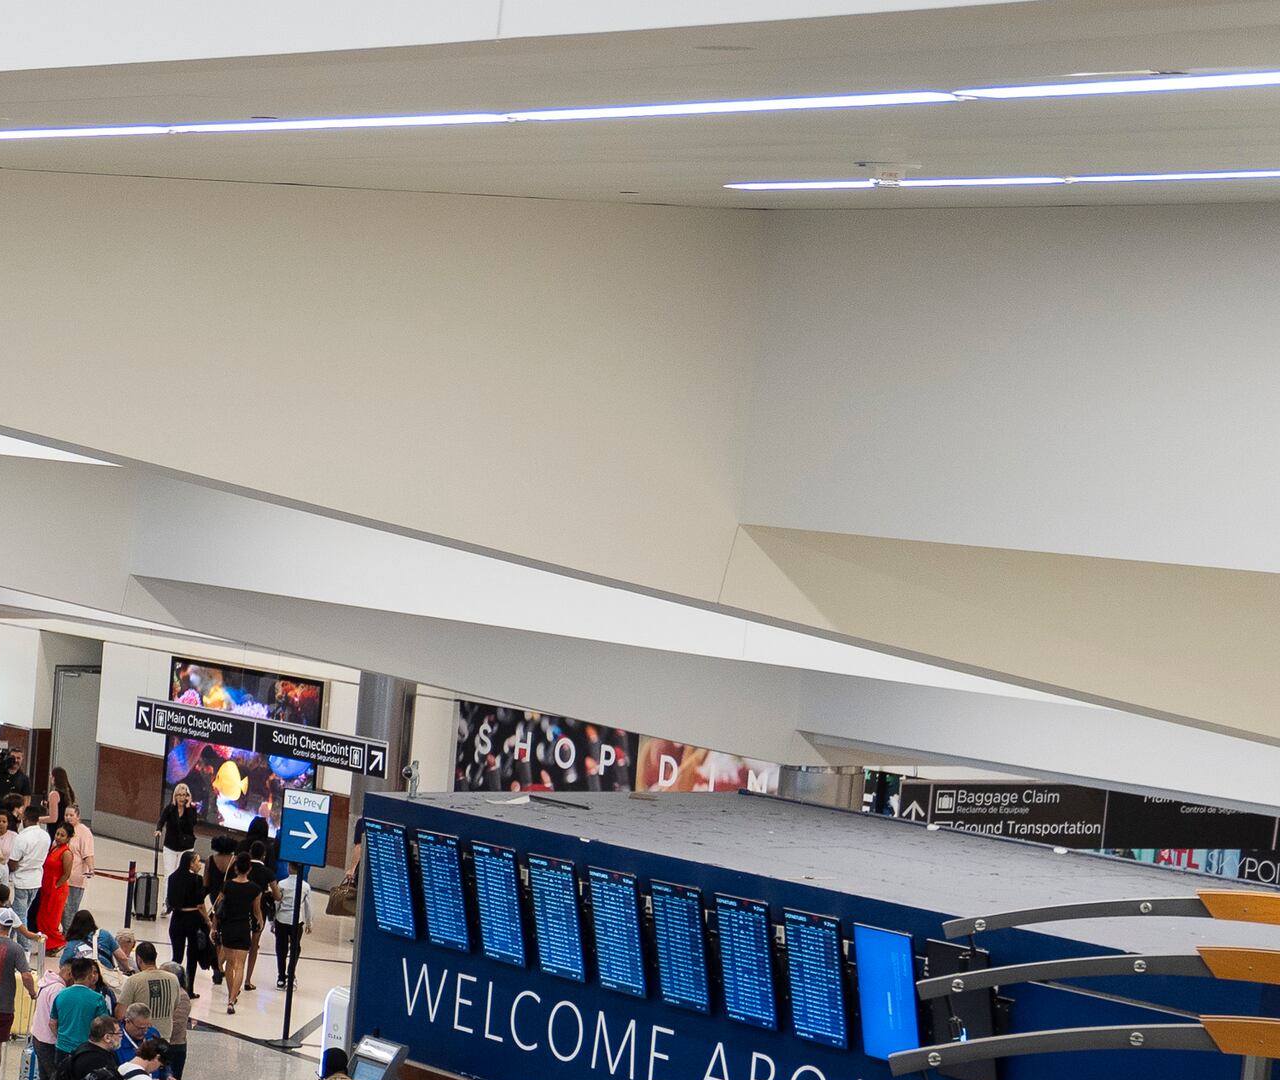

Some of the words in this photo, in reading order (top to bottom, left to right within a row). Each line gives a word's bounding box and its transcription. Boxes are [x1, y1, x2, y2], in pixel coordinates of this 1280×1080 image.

[167, 711, 186, 725] Main
[187, 715, 233, 734] Checkpoint
[166, 724, 182, 733] Control
[188, 728, 210, 739] Seguridad
[272, 730, 298, 747] South
[299, 736, 349, 757] Checkpoint
[478, 719, 617, 777] SHOP
[292, 749, 310, 759] Control
[310, 752, 317, 760] de
[317, 753, 340, 764] Seguridad
[340, 757, 349, 766] Sur
[287, 795, 303, 806] TSA
[957, 790, 1018, 806] Baggage
[1022, 790, 1060, 804] Claim
[956, 806, 987, 814] Reclamo
[988, 806, 998, 814] de
[998, 806, 1030, 815] Equipaje
[1180, 805, 1206, 814] Control
[1207, 806, 1218, 814] de
[955, 820, 1003, 835] Ground
[1007, 820, 1101, 837] Transportation
[1155, 848, 1200, 870] ATL
